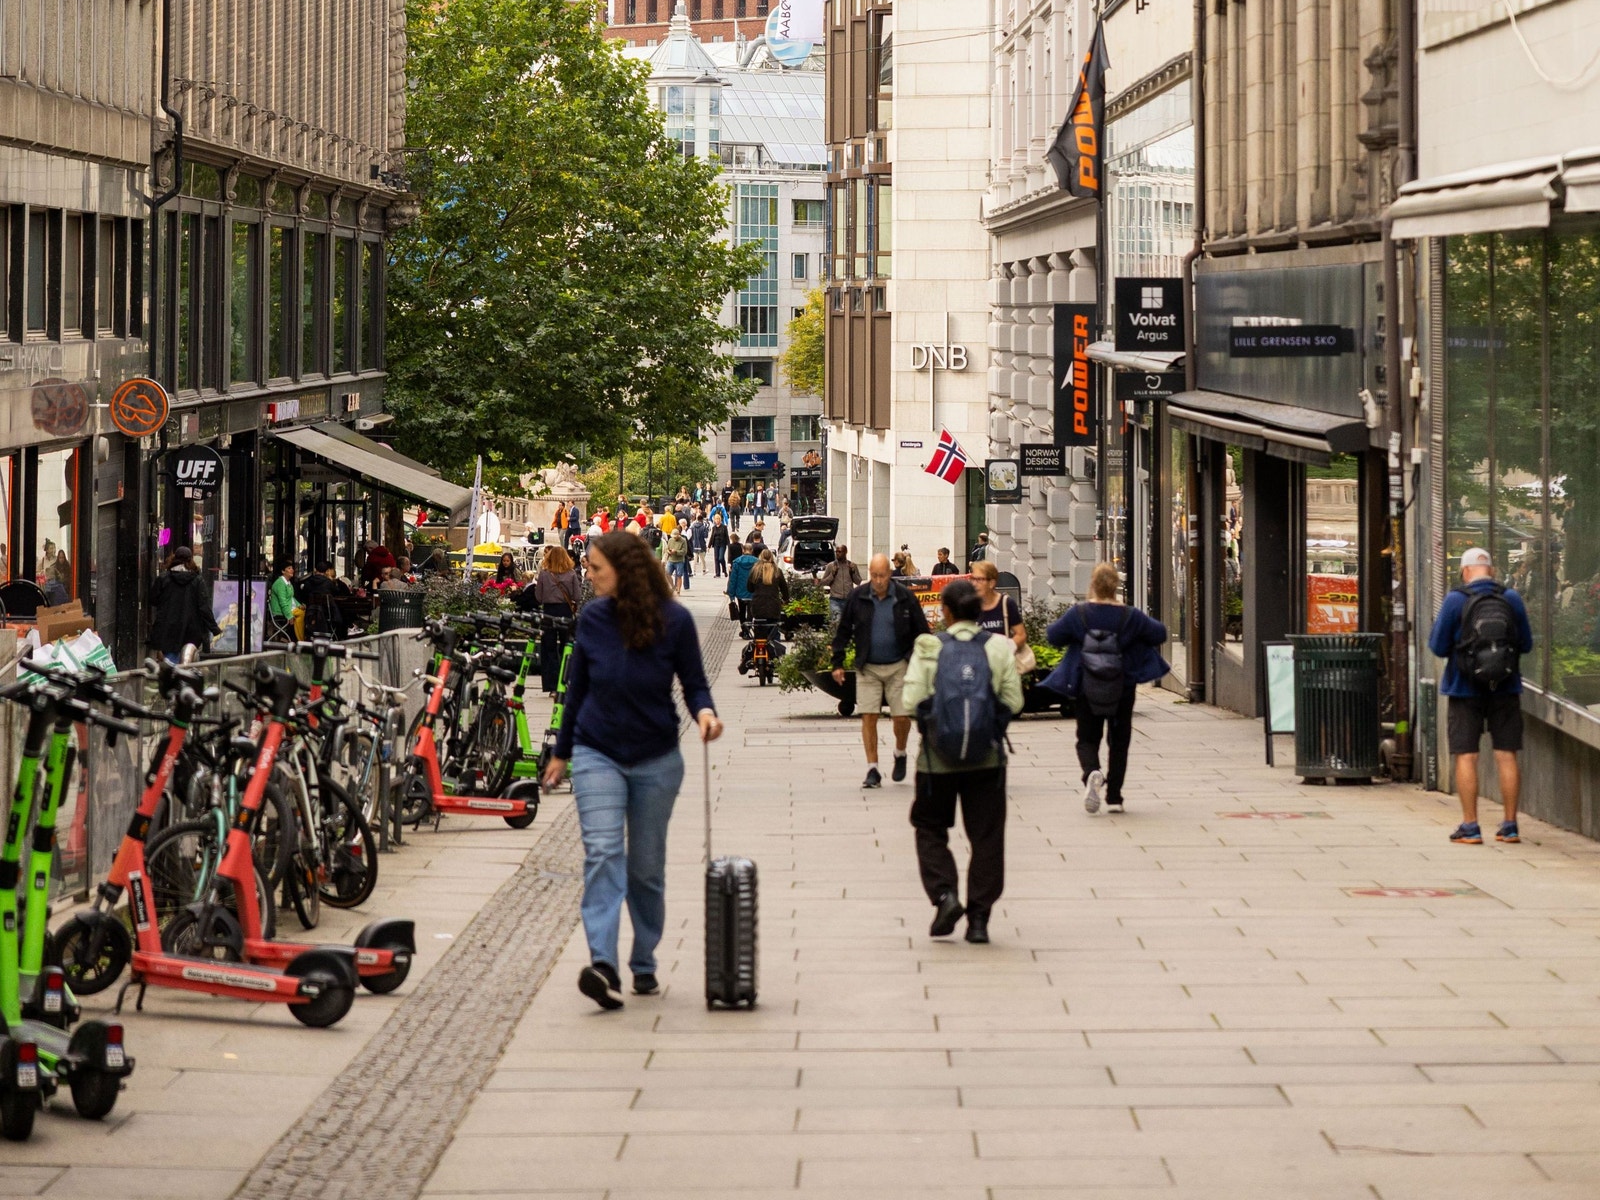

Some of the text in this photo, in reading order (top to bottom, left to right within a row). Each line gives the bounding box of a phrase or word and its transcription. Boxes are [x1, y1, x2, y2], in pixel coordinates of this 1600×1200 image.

[780, 0, 791, 38] AABØ
[1128, 313, 1176, 326] Volvat
[1136, 330, 1168, 342] Argus
[1234, 335, 1337, 346] LILLE GRENSEN SKO
[910, 343, 968, 371] DNB
[1073, 314, 1088, 435] POWER
[1025, 457, 1060, 465] DESIGNS
[176, 460, 217, 478] UFF
